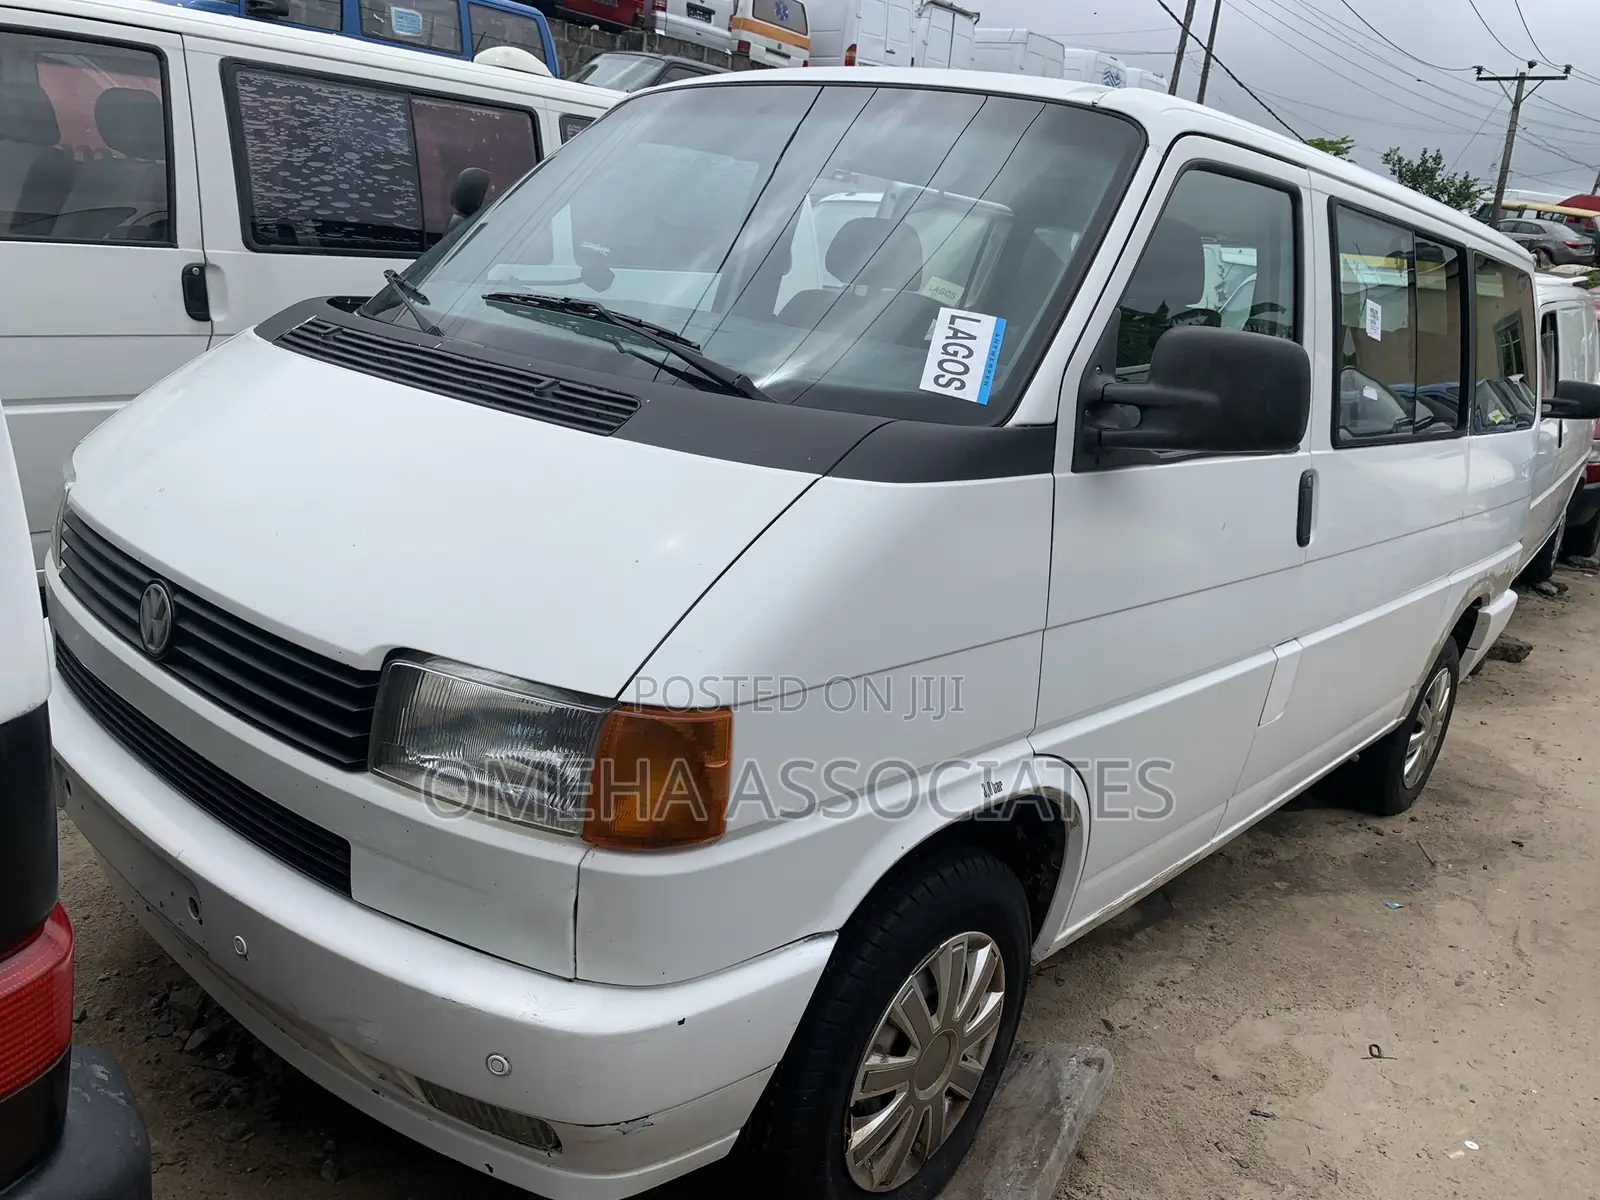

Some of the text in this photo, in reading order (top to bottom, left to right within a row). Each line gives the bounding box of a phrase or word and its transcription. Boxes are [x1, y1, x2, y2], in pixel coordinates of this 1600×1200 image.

[933, 314, 981, 391] LAGOS
[983, 333, 1000, 387] ANTWERPEN
[991, 781, 1003, 794] bar
